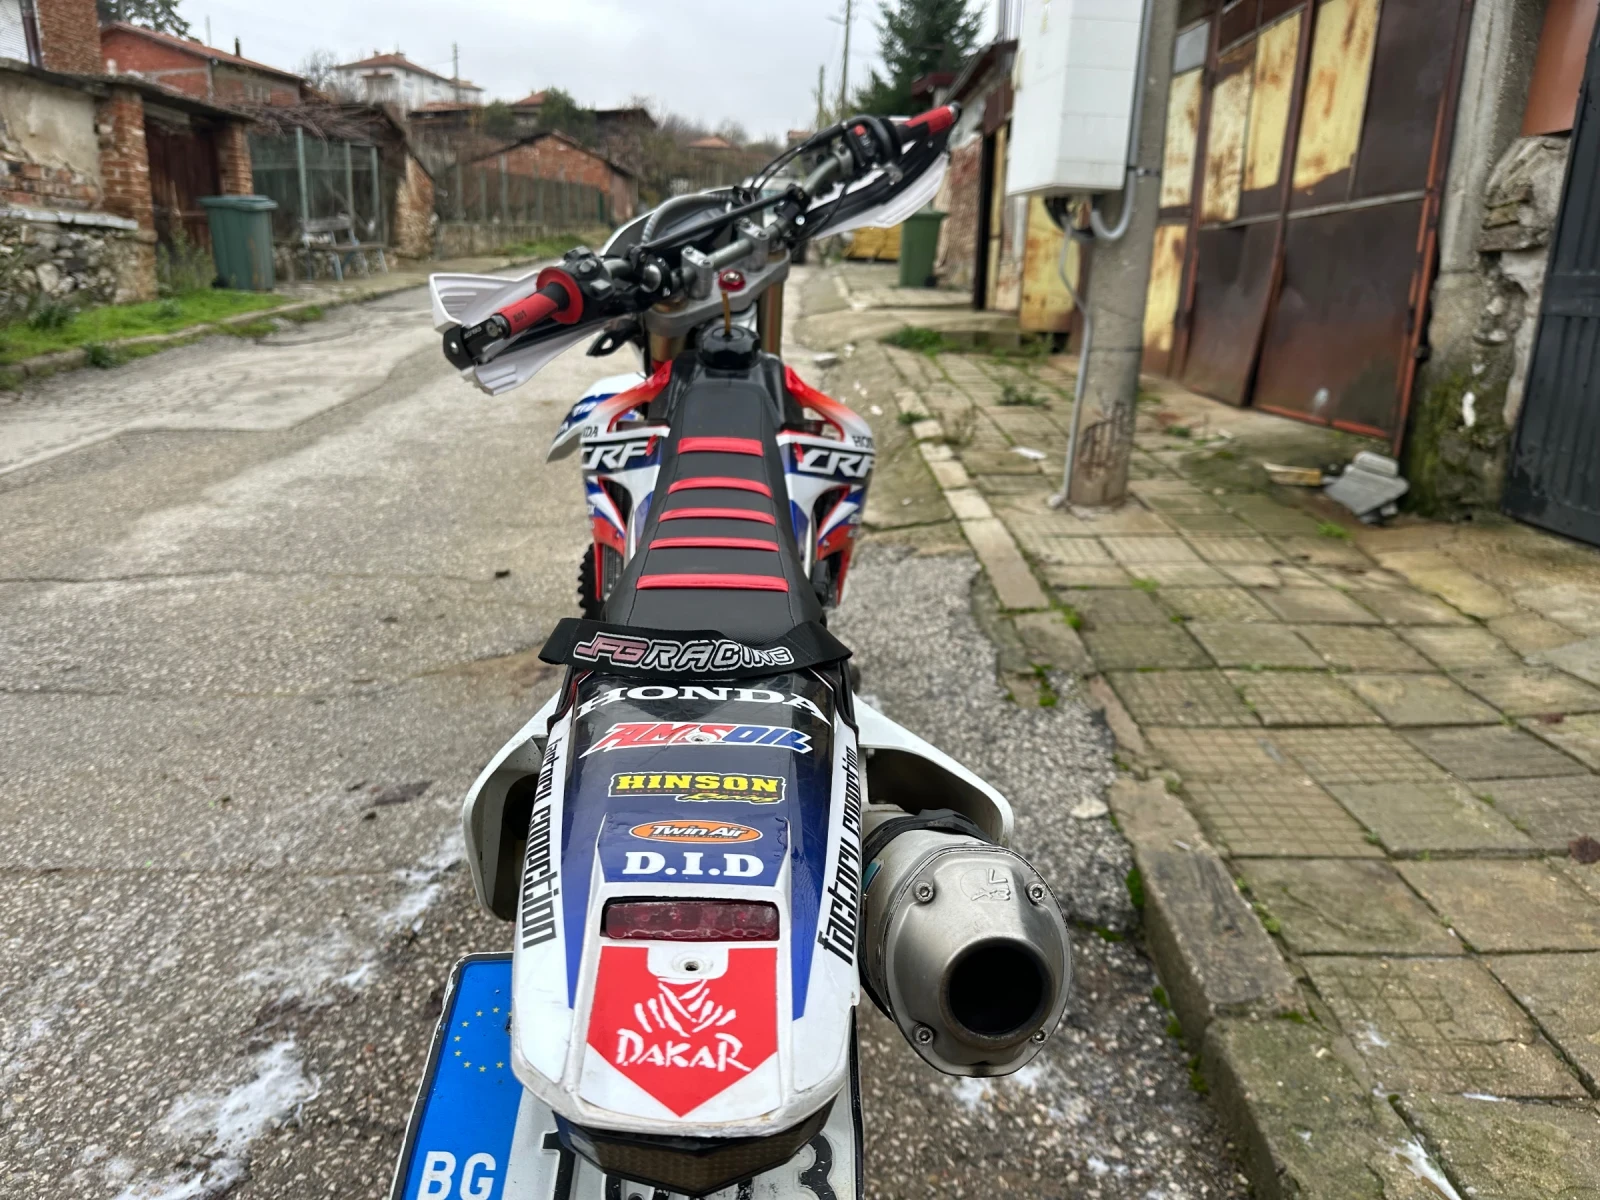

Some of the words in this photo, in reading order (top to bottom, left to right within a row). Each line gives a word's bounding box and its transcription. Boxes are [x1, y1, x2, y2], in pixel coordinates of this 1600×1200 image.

[642, 639, 795, 670] RACING
[575, 685, 832, 727] HONDA
[578, 721, 813, 760] AMSOIL
[616, 774, 779, 793] HINSON
[651, 825, 707, 836] Twin
[707, 827, 748, 838] Air
[622, 851, 764, 878] D.I.D
[616, 1028, 753, 1072] DAKAR
[416, 1150, 497, 1200] BG
